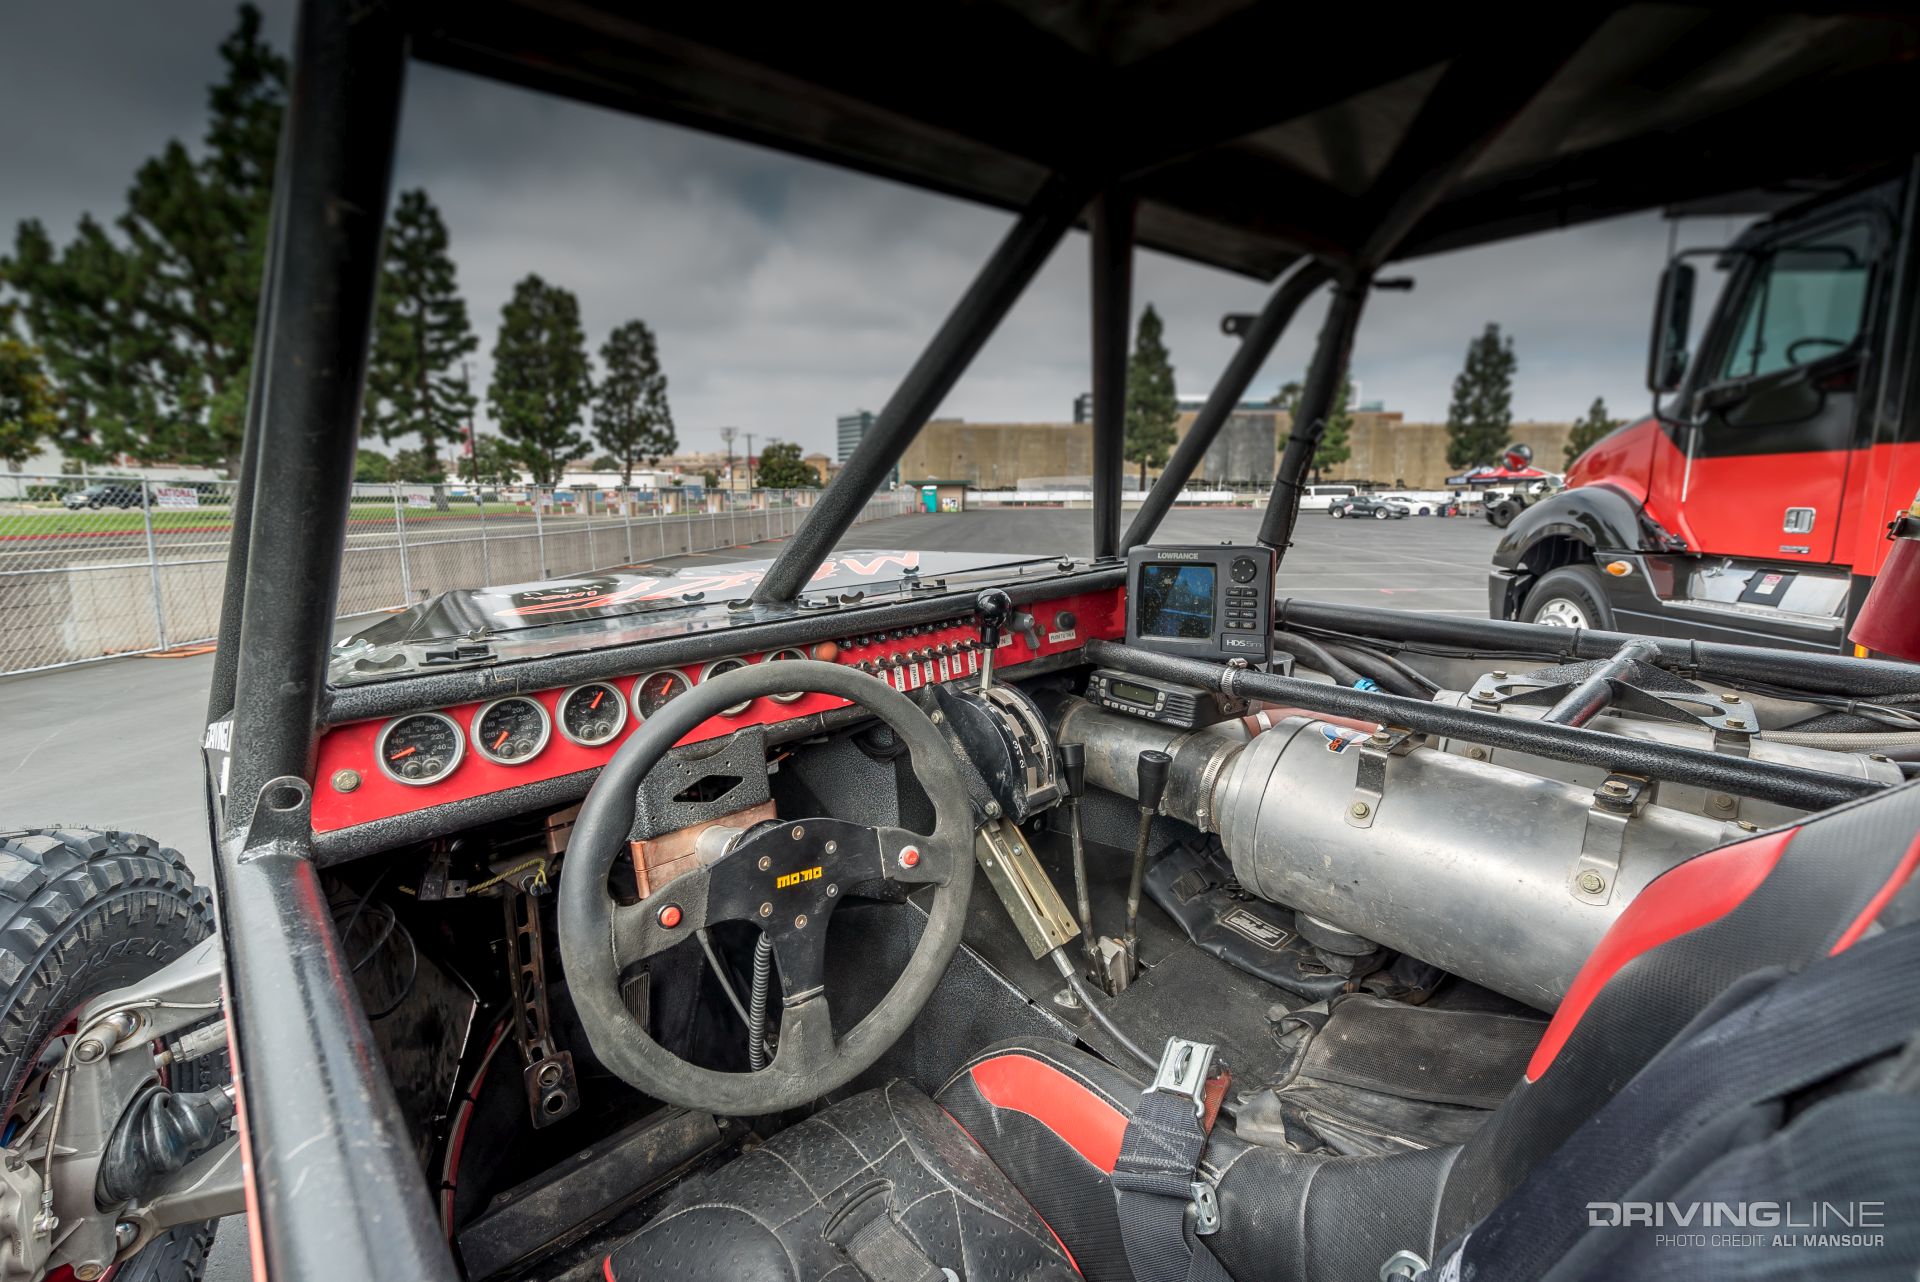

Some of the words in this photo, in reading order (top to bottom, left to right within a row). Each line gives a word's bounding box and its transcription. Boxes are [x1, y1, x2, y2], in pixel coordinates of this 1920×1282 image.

[1157, 552, 1199, 560] LOWRANCE
[511, 706, 525, 714] 200
[518, 714, 531, 722] 220
[411, 720, 425, 728] 180
[424, 724, 440, 732] 200
[520, 724, 534, 732] 240
[430, 733, 445, 741] 220
[484, 731, 496, 739] 120
[432, 744, 447, 752] 240
